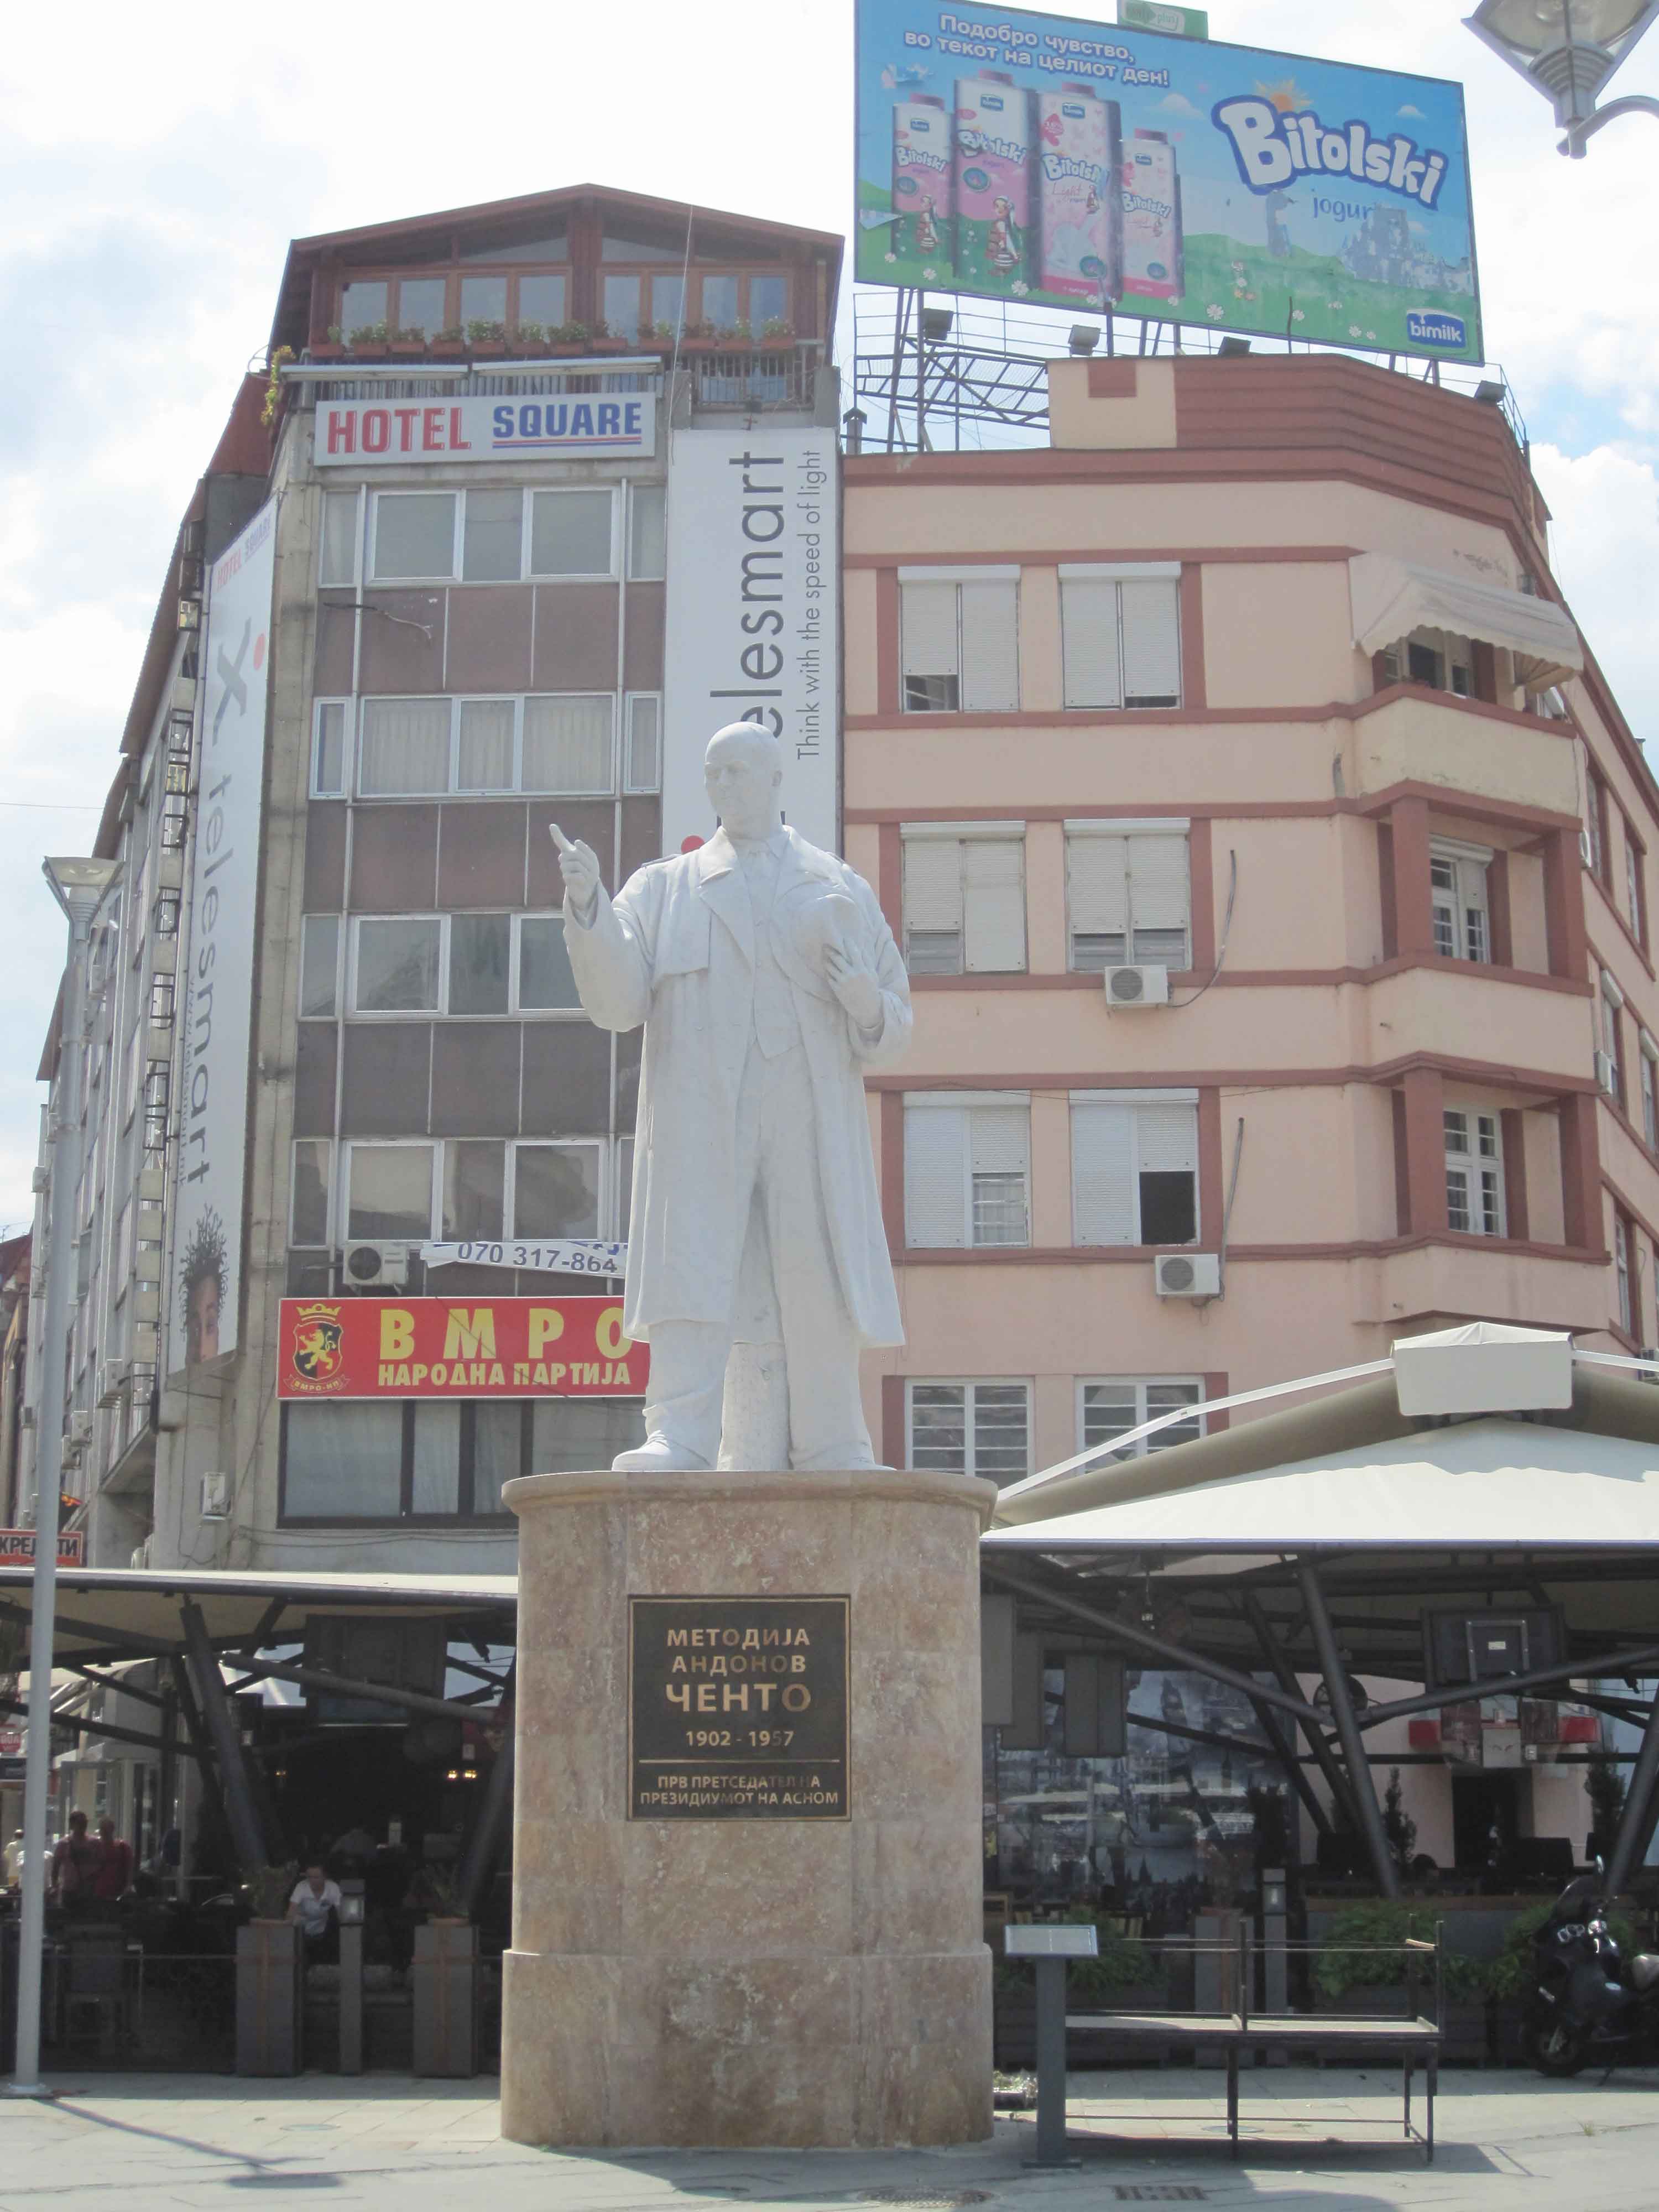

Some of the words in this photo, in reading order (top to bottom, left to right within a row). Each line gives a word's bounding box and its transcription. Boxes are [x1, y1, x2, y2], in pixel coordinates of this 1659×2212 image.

[940, 15, 1037, 46] Подобро
[1045, 34, 1135, 63] чувство,
[905, 31, 931, 47] во
[938, 36, 998, 59] текот
[1004, 49, 1031, 65] на
[1039, 54, 1116, 78] целиот
[1123, 67, 1170, 86] ден!
[1214, 97, 1446, 208] Bitolski
[1311, 187, 1378, 222] jogur
[1411, 321, 1462, 342] bimilk
[327, 407, 471, 454] HOTEL
[493, 403, 642, 438] SQUARE
[797, 450, 827, 495] light
[796, 503, 820, 524] of
[796, 534, 827, 598] speed
[710, 451, 784, 739] elesmart
[796, 608, 820, 640] the
[796, 649, 820, 695] with
[796, 702, 820, 760] Think
[458, 1242, 504, 1264] 070
[513, 1245, 618, 1274] 317-864
[378, 1363, 507, 1386] НАРОДНА
[513, 1362, 631, 1385] ПАРТИЈА
[0, 1536, 78, 1557] КРЕТИ
[667, 1628, 810, 1650] МЕТОДИЈА
[671, 1655, 806, 1676] АНДОНОВ
[665, 1683, 811, 1713] ЧЕНТО
[686, 1730, 731, 1747] 1902
[749, 1730, 795, 1747] 1957
[640, 1792, 754, 1807] ПРЕЗИДИУМОТ
[758, 1792, 779, 1804] НА
[782, 1791, 839, 1805] АСНОМ
[658, 1776, 688, 1788] ПРВ
[692, 1776, 796, 1791] ПРЕТСЕДАТЕЛ
[801, 1776, 820, 1788] НА
